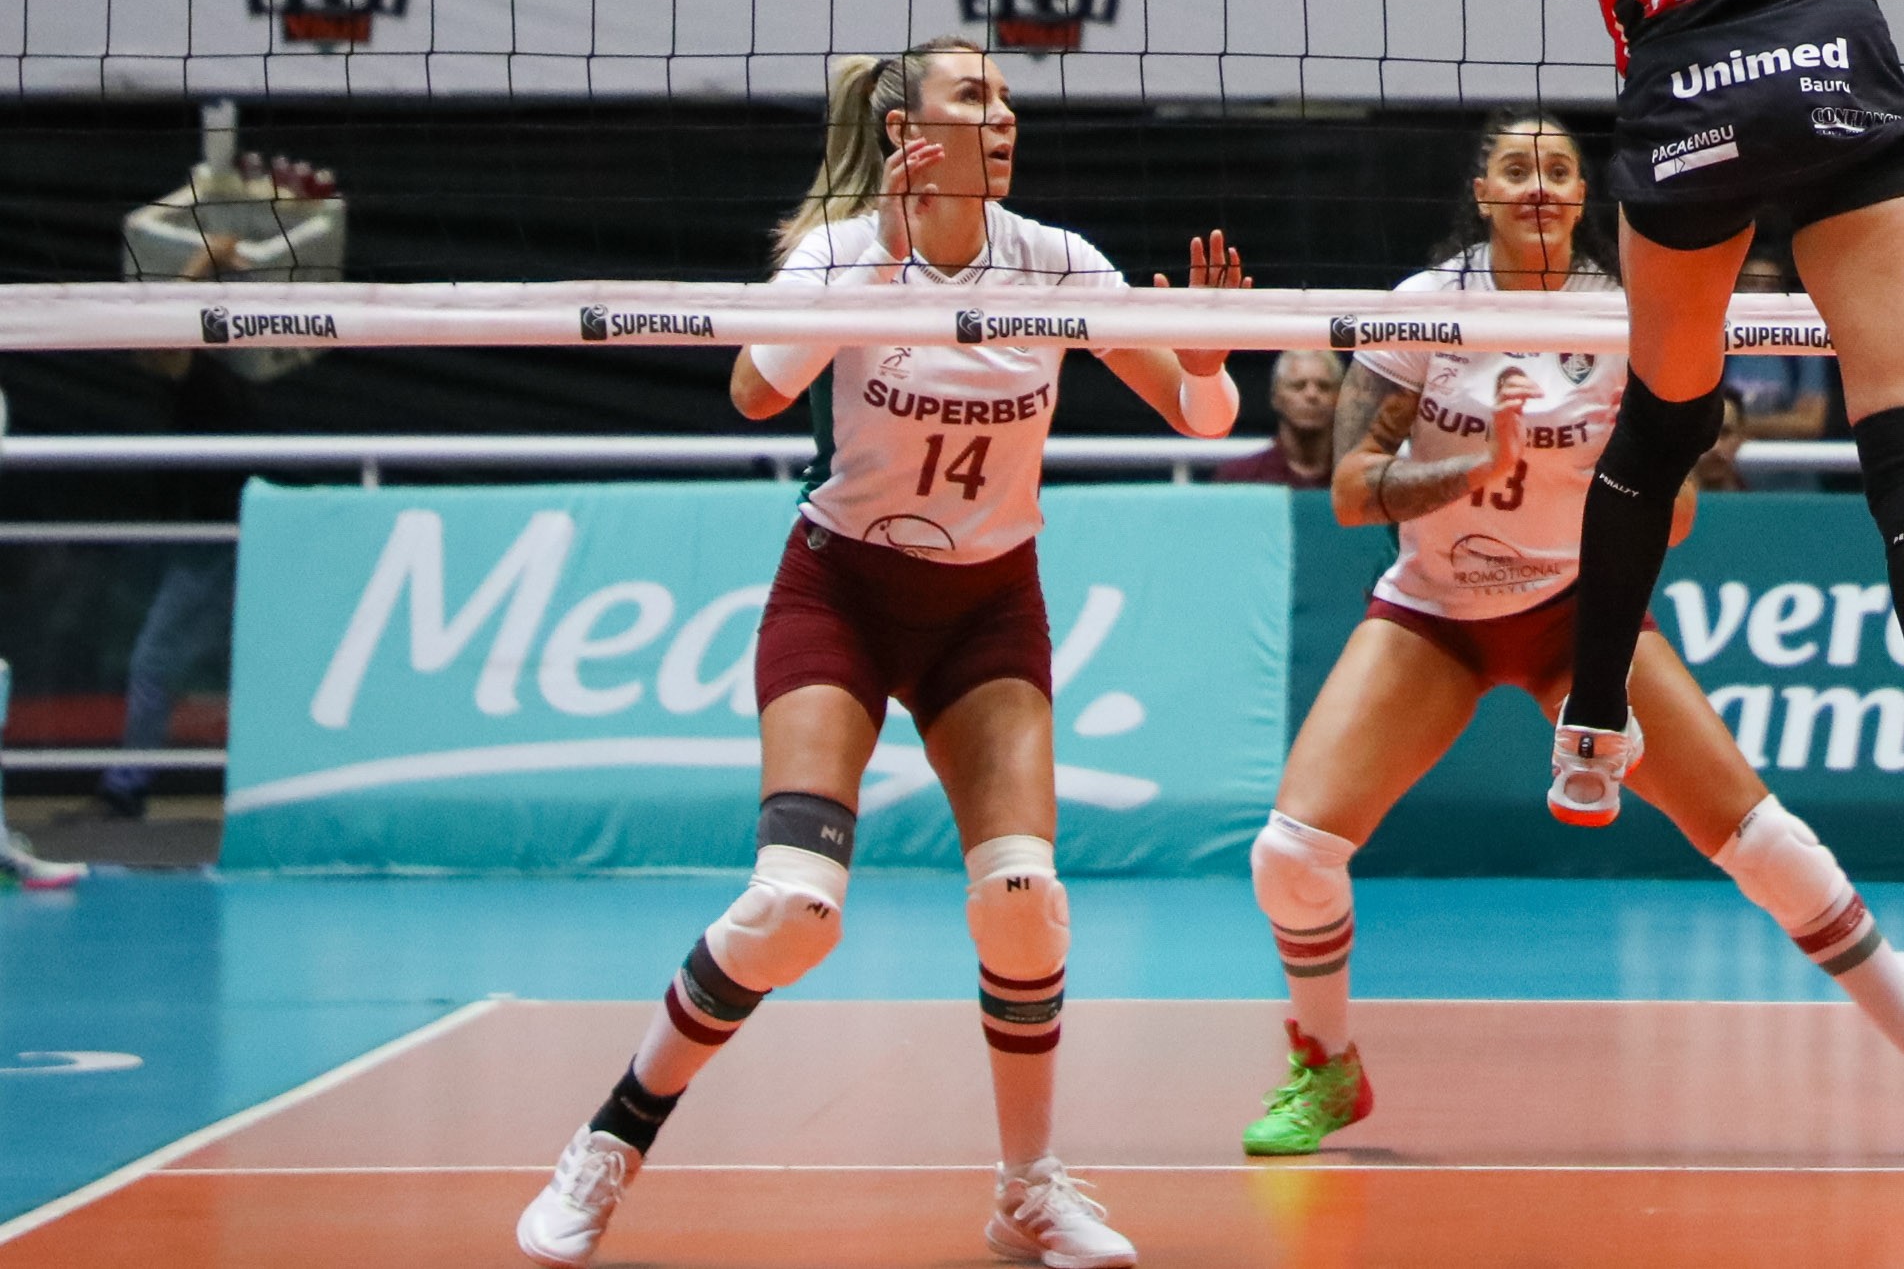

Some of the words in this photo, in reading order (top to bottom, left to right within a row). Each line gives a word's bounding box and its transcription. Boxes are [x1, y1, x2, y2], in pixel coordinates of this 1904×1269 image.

[1671, 37, 1849, 100] Unimed
[1800, 77, 1852, 94] Bauru
[1652, 124, 1734, 163] PACAEMBU
[232, 314, 338, 340] SUPERLIGA
[611, 311, 714, 338] SUPERLIGA
[986, 316, 1089, 341] SUPERLIGA
[1360, 321, 1463, 346] SUPERLIGA
[863, 377, 1053, 424] SUPERBET
[1420, 397, 1588, 449] SUPBET
[916, 434, 992, 500] 14
